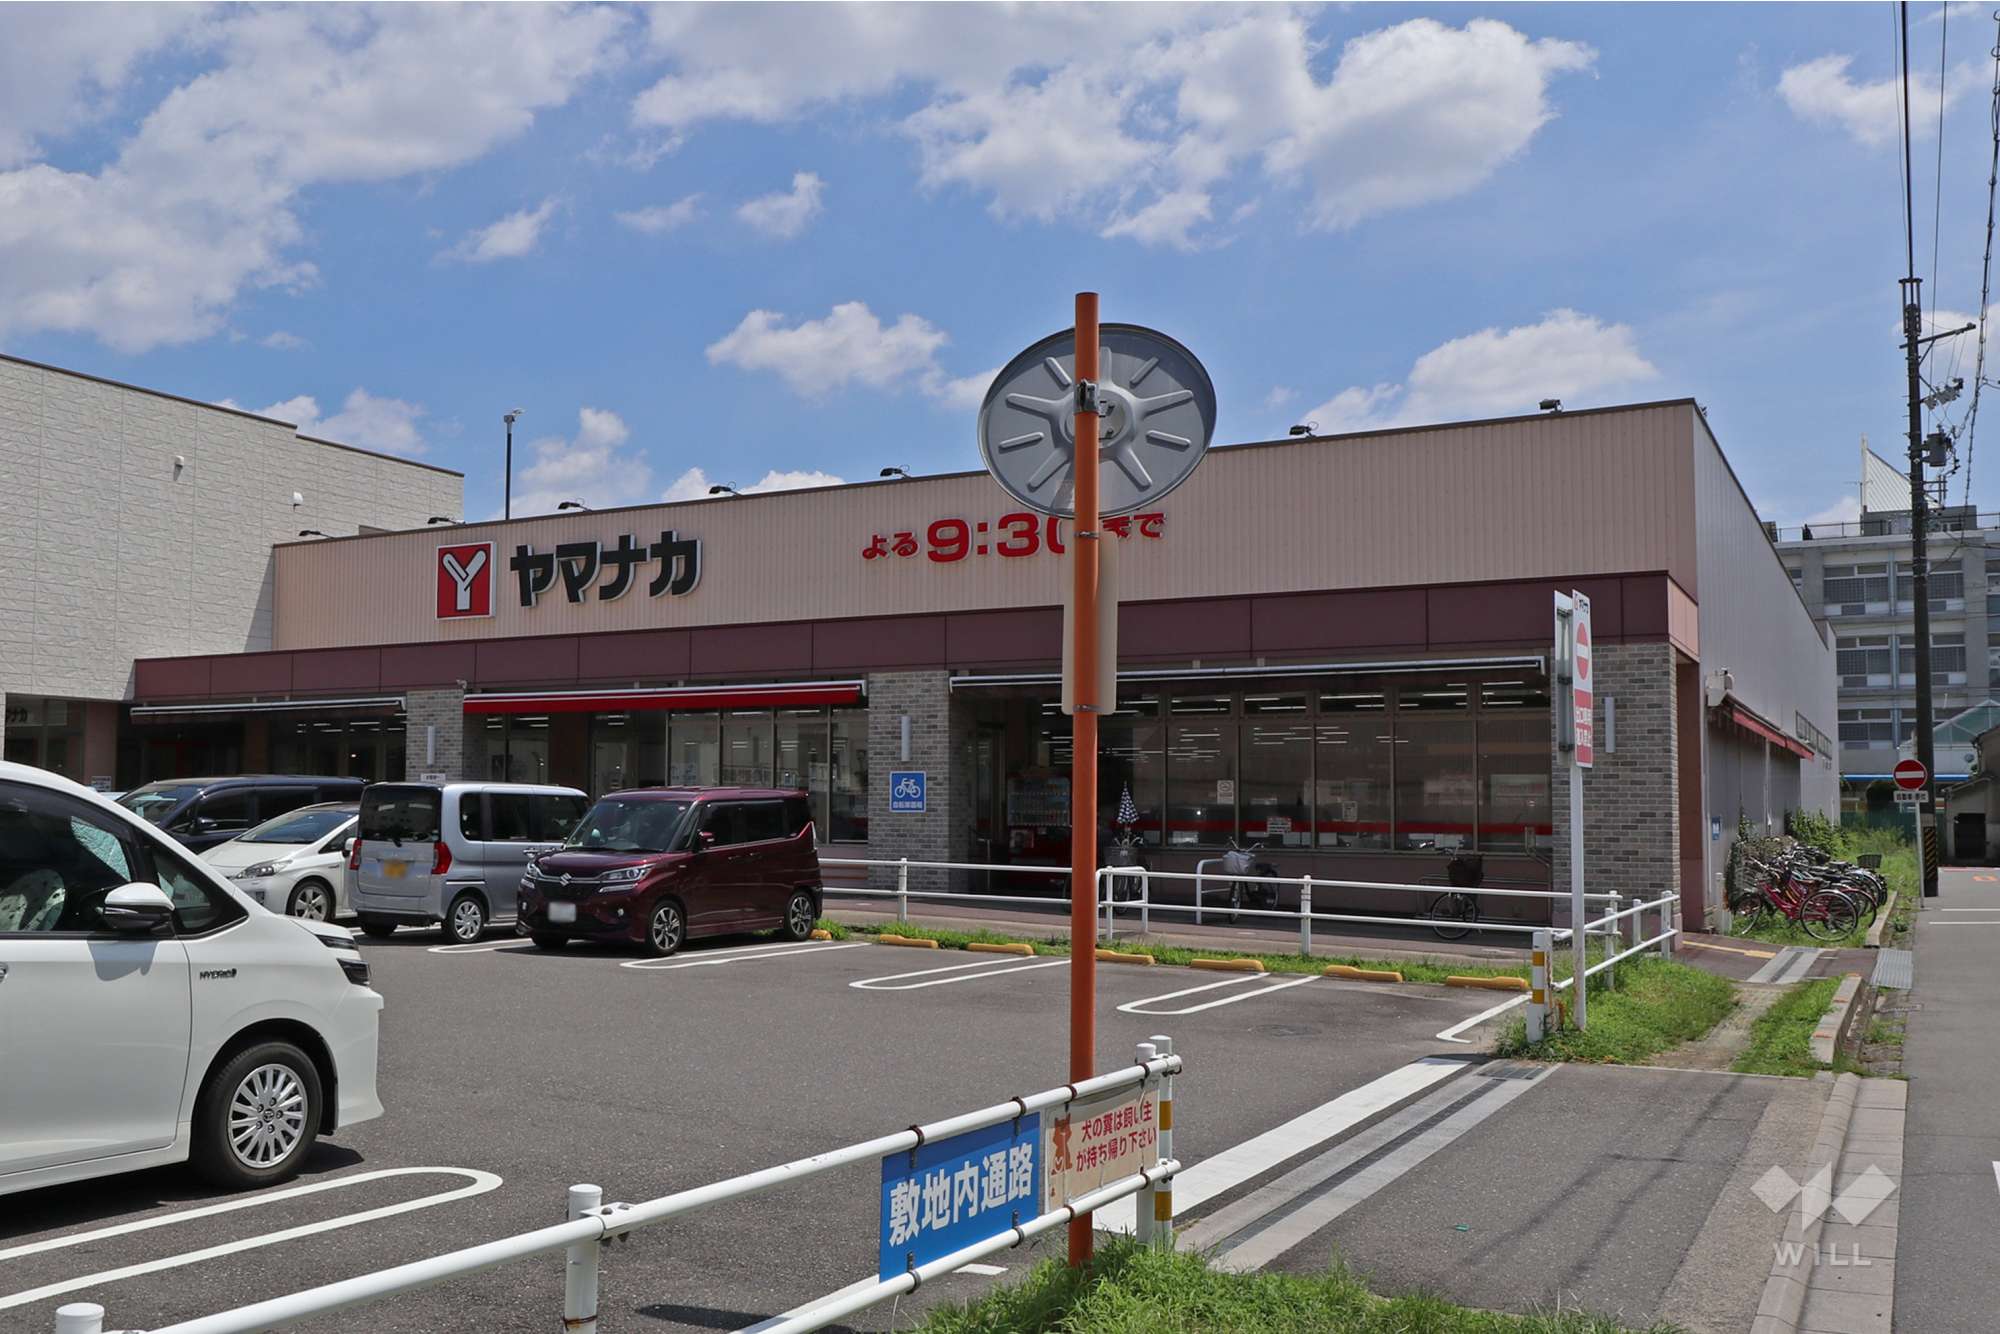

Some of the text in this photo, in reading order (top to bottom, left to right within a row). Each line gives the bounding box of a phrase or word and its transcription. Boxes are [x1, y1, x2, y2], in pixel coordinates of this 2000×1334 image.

[509, 530, 703, 608] ヤマナカ
[1076, 1127, 1157, 1172] が持ち帰り下さい
[888, 1143, 1034, 1247] 敷地内通路
